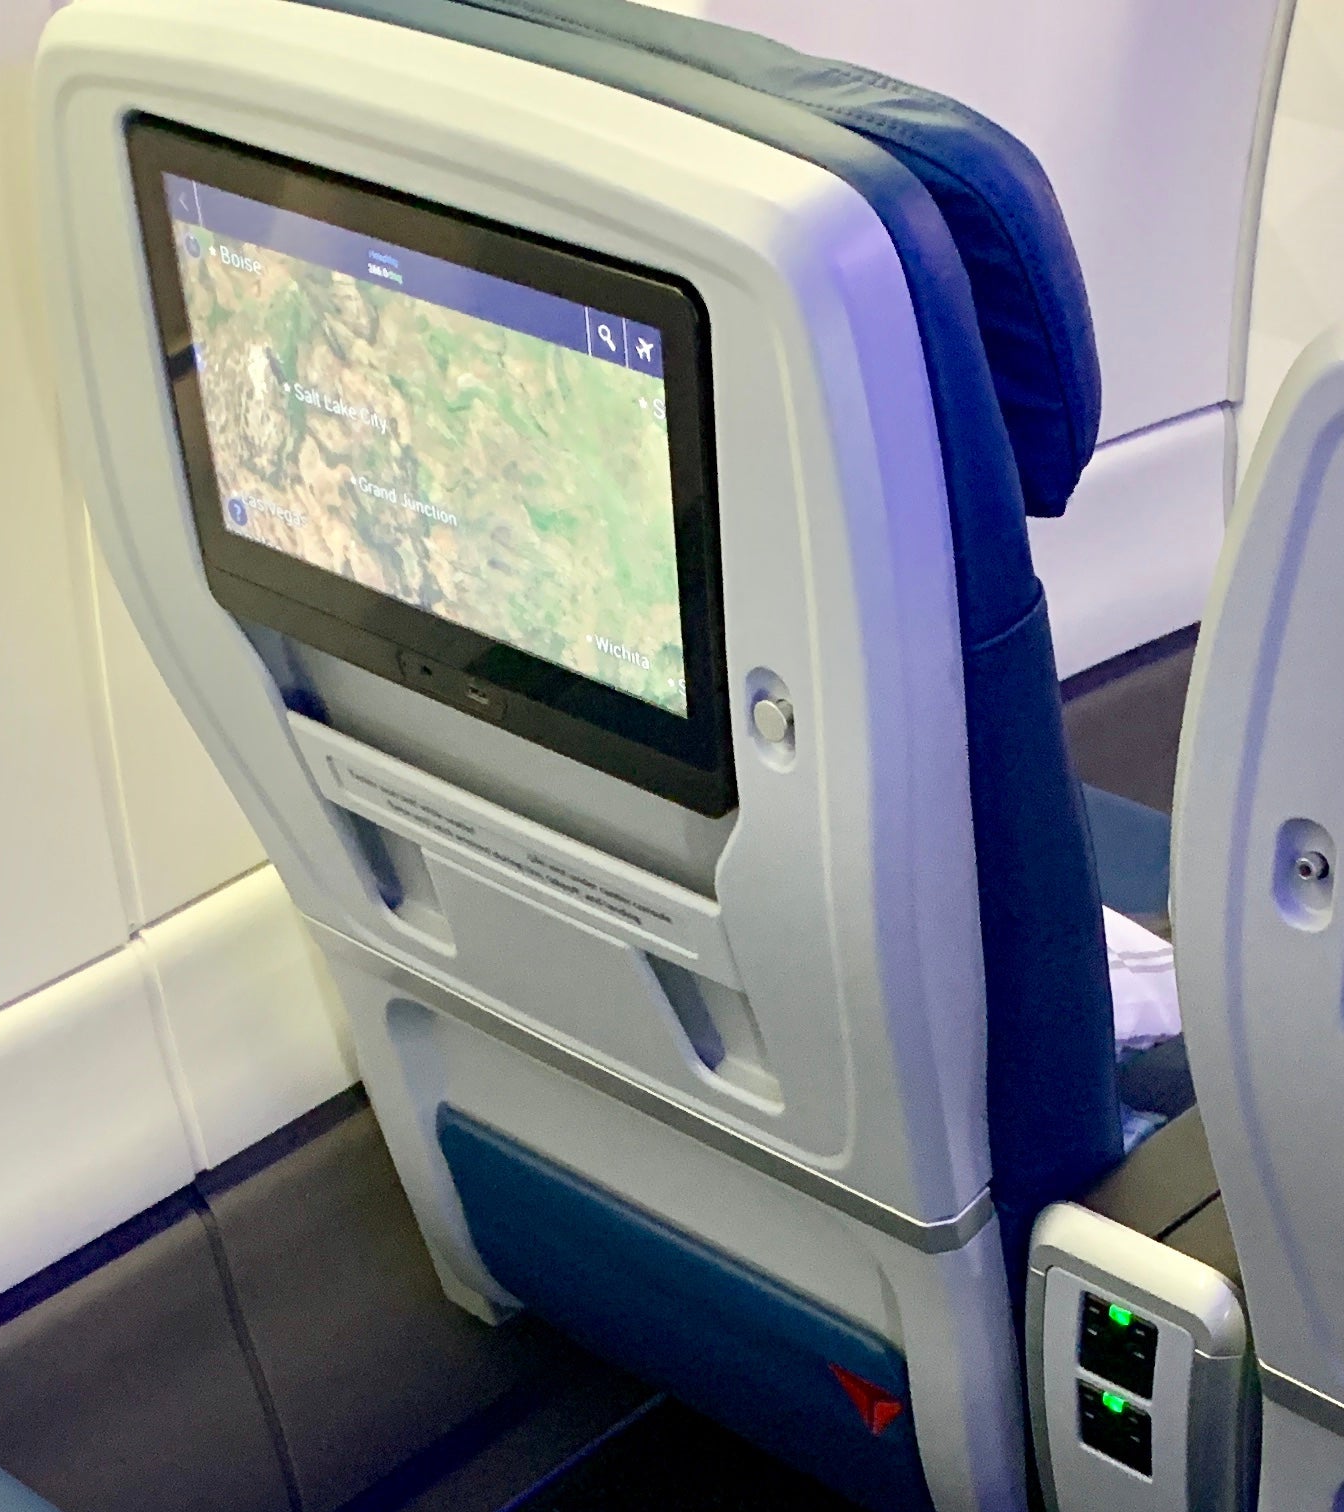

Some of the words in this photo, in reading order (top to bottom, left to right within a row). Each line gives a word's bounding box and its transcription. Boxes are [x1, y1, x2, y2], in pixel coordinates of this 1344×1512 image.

[219, 246, 262, 275] Boise
[293, 382, 322, 408] Salt
[323, 394, 357, 420] Lake
[359, 406, 387, 435] City
[358, 476, 396, 504] Grand
[401, 492, 458, 528] Junction
[596, 634, 650, 670] Wichita
